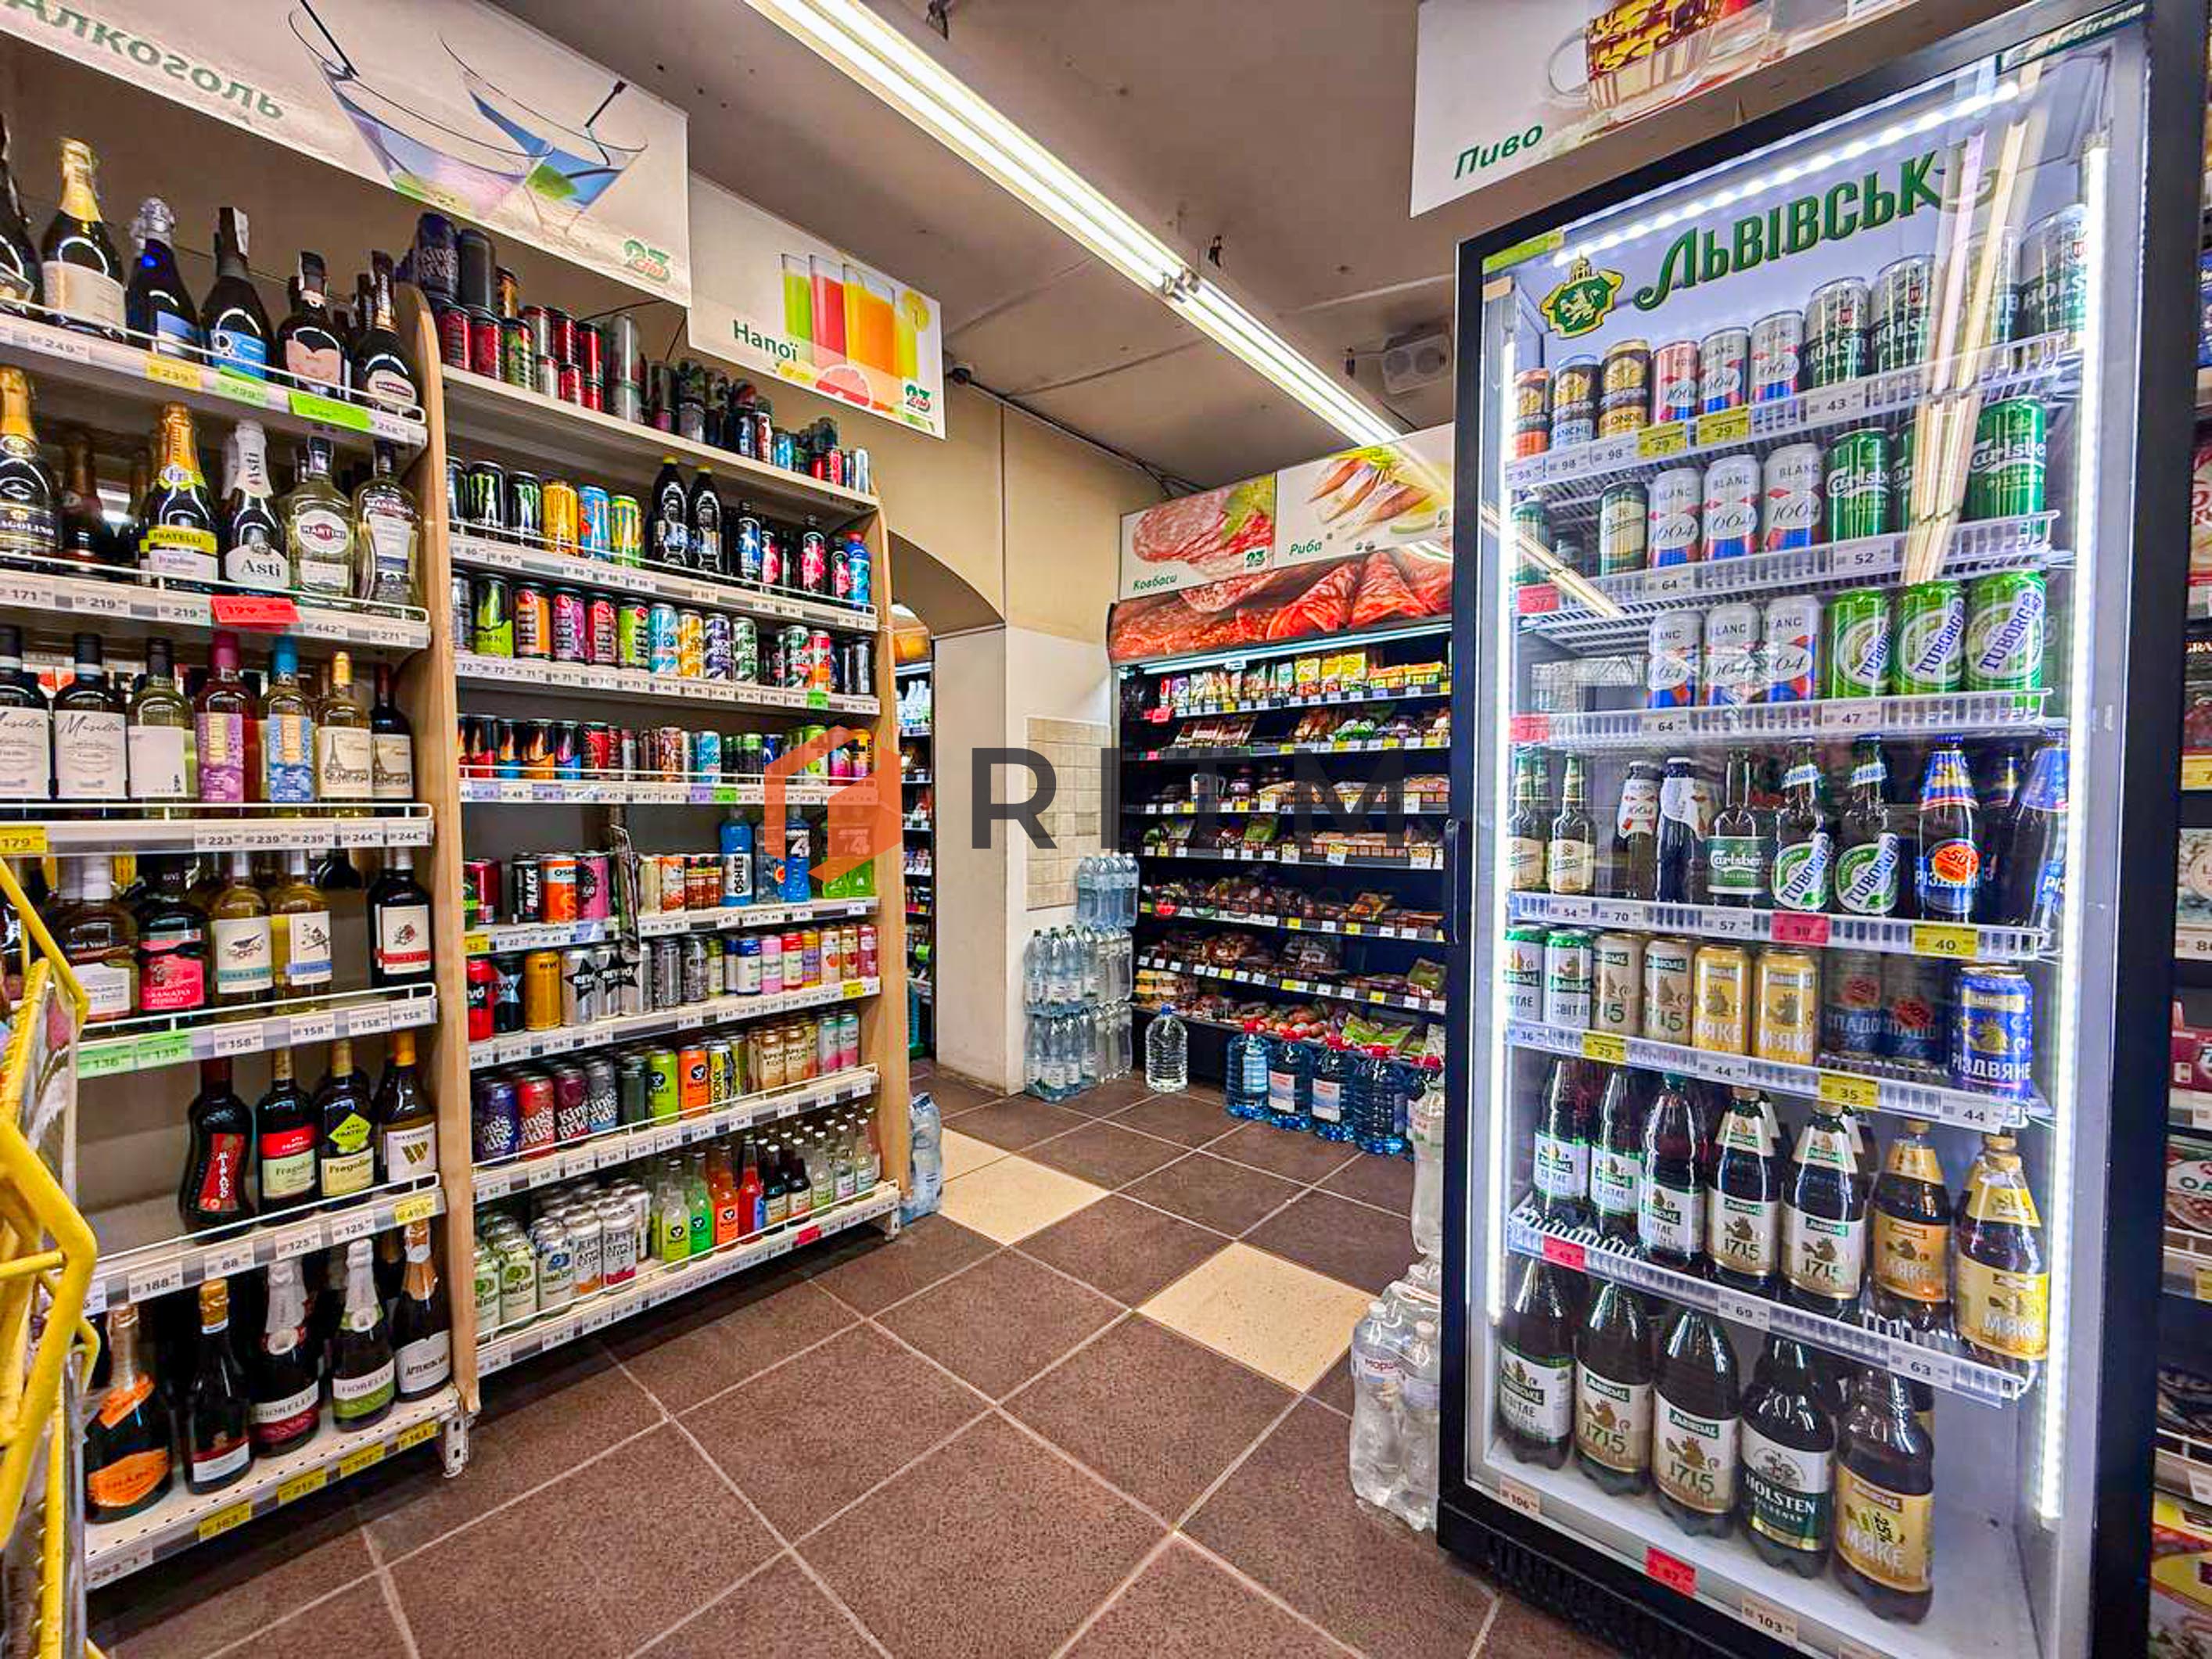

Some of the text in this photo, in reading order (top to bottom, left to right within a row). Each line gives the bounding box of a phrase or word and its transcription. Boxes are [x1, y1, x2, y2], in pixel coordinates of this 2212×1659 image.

[1453, 123, 1543, 180] Пиво
[734, 319, 798, 363] Напої
[1827, 397, 1847, 411] 43
[1715, 425, 1733, 437] 29
[1607, 448, 1624, 460] 98
[246, 451, 260, 486] Asti
[1561, 458, 1576, 470] 98
[153, 532, 202, 544] FRATELLI
[300, 522, 347, 541] MARTINI
[1289, 539, 1323, 557] Риба
[1855, 551, 1876, 566] 52
[240, 558, 282, 578] Asti
[1662, 579, 1677, 591] 64
[11, 588, 38, 601] 171
[89, 598, 117, 609] 219
[173, 607, 198, 619] 219
[1913, 611, 1964, 675] TUBORG
[1977, 605, 2035, 673] TUBORG
[1841, 713, 1862, 725] 47
[1658, 721, 1674, 732] 64
[208, 836, 233, 846] 223
[257, 835, 280, 845] 239
[352, 834, 373, 842] 244
[398, 831, 418, 841] 244
[2, 838, 30, 848] 179
[734, 855, 744, 894] OSHEE
[525, 863, 539, 907] BLACK
[1564, 908, 1578, 918] 54
[1614, 912, 1628, 922] 70
[1720, 921, 1736, 932] 57
[1934, 939, 1956, 951] 40
[1714, 1066, 1732, 1077] 44
[1840, 1088, 1859, 1101] 35
[1962, 1108, 1986, 1123] 44
[345, 1223, 364, 1235] 125
[1724, 1237, 1759, 1261] 1715
[1803, 1259, 1840, 1281] 1715
[1735, 1306, 1753, 1319] 69
[1910, 1362, 1931, 1376] 63
[1585, 1422, 1626, 1455] 1715
[1669, 1460, 1715, 1494] 1715
[1745, 1472, 1816, 1515] HOLSTEN
[1757, 1614, 1783, 1635] 103
